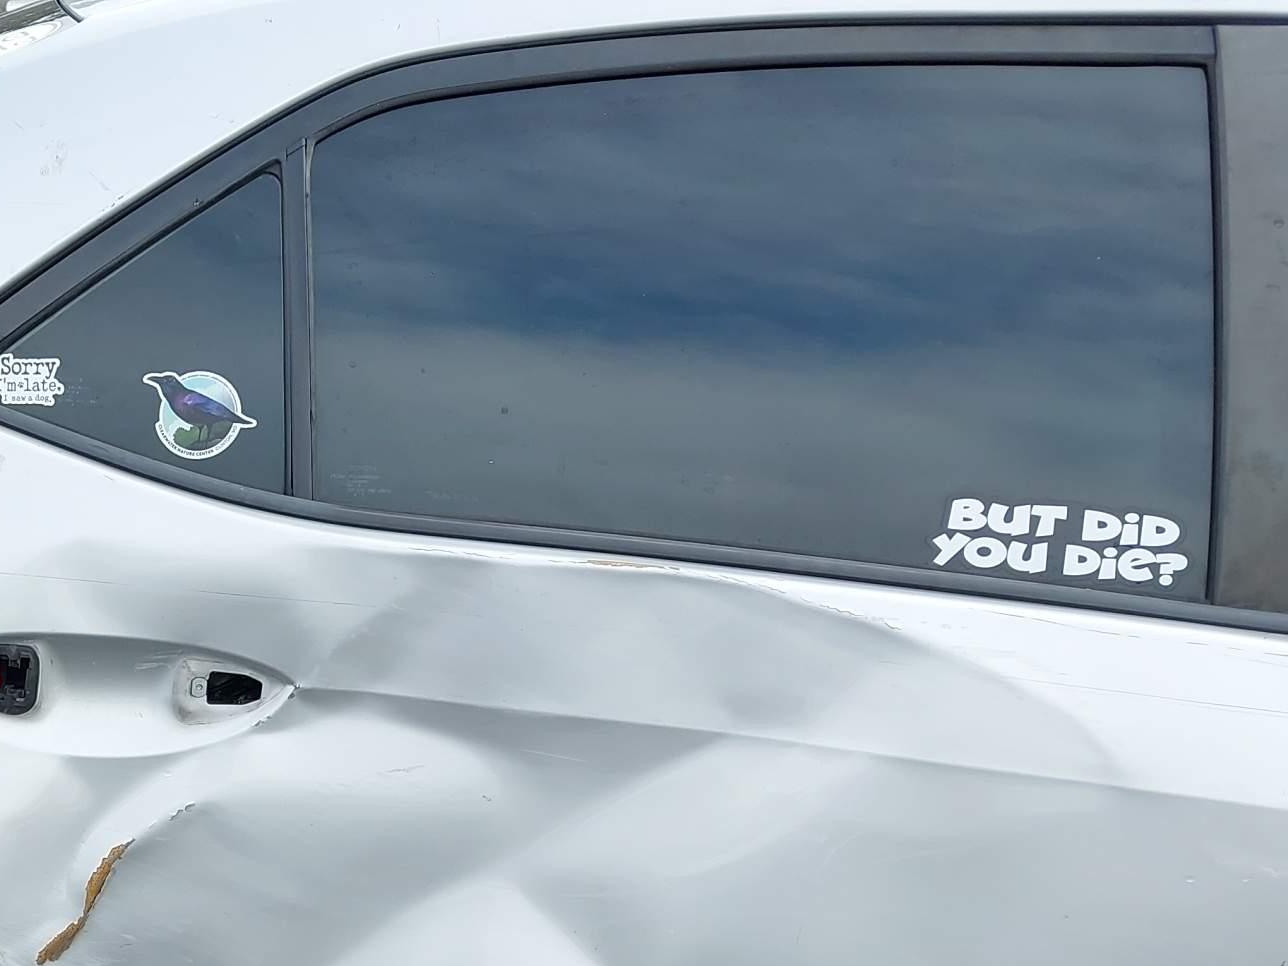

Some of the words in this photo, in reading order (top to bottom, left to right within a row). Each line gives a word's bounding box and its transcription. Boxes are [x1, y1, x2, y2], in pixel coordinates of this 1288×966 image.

[0, 356, 57, 380] Sorry
[24, 378, 61, 392] late.
[3, 394, 8, 402] I
[35, 394, 52, 403] dog.
[177, 447, 195, 457] NATURE
[947, 498, 1068, 536] BUT
[932, 532, 1049, 574] YOU
